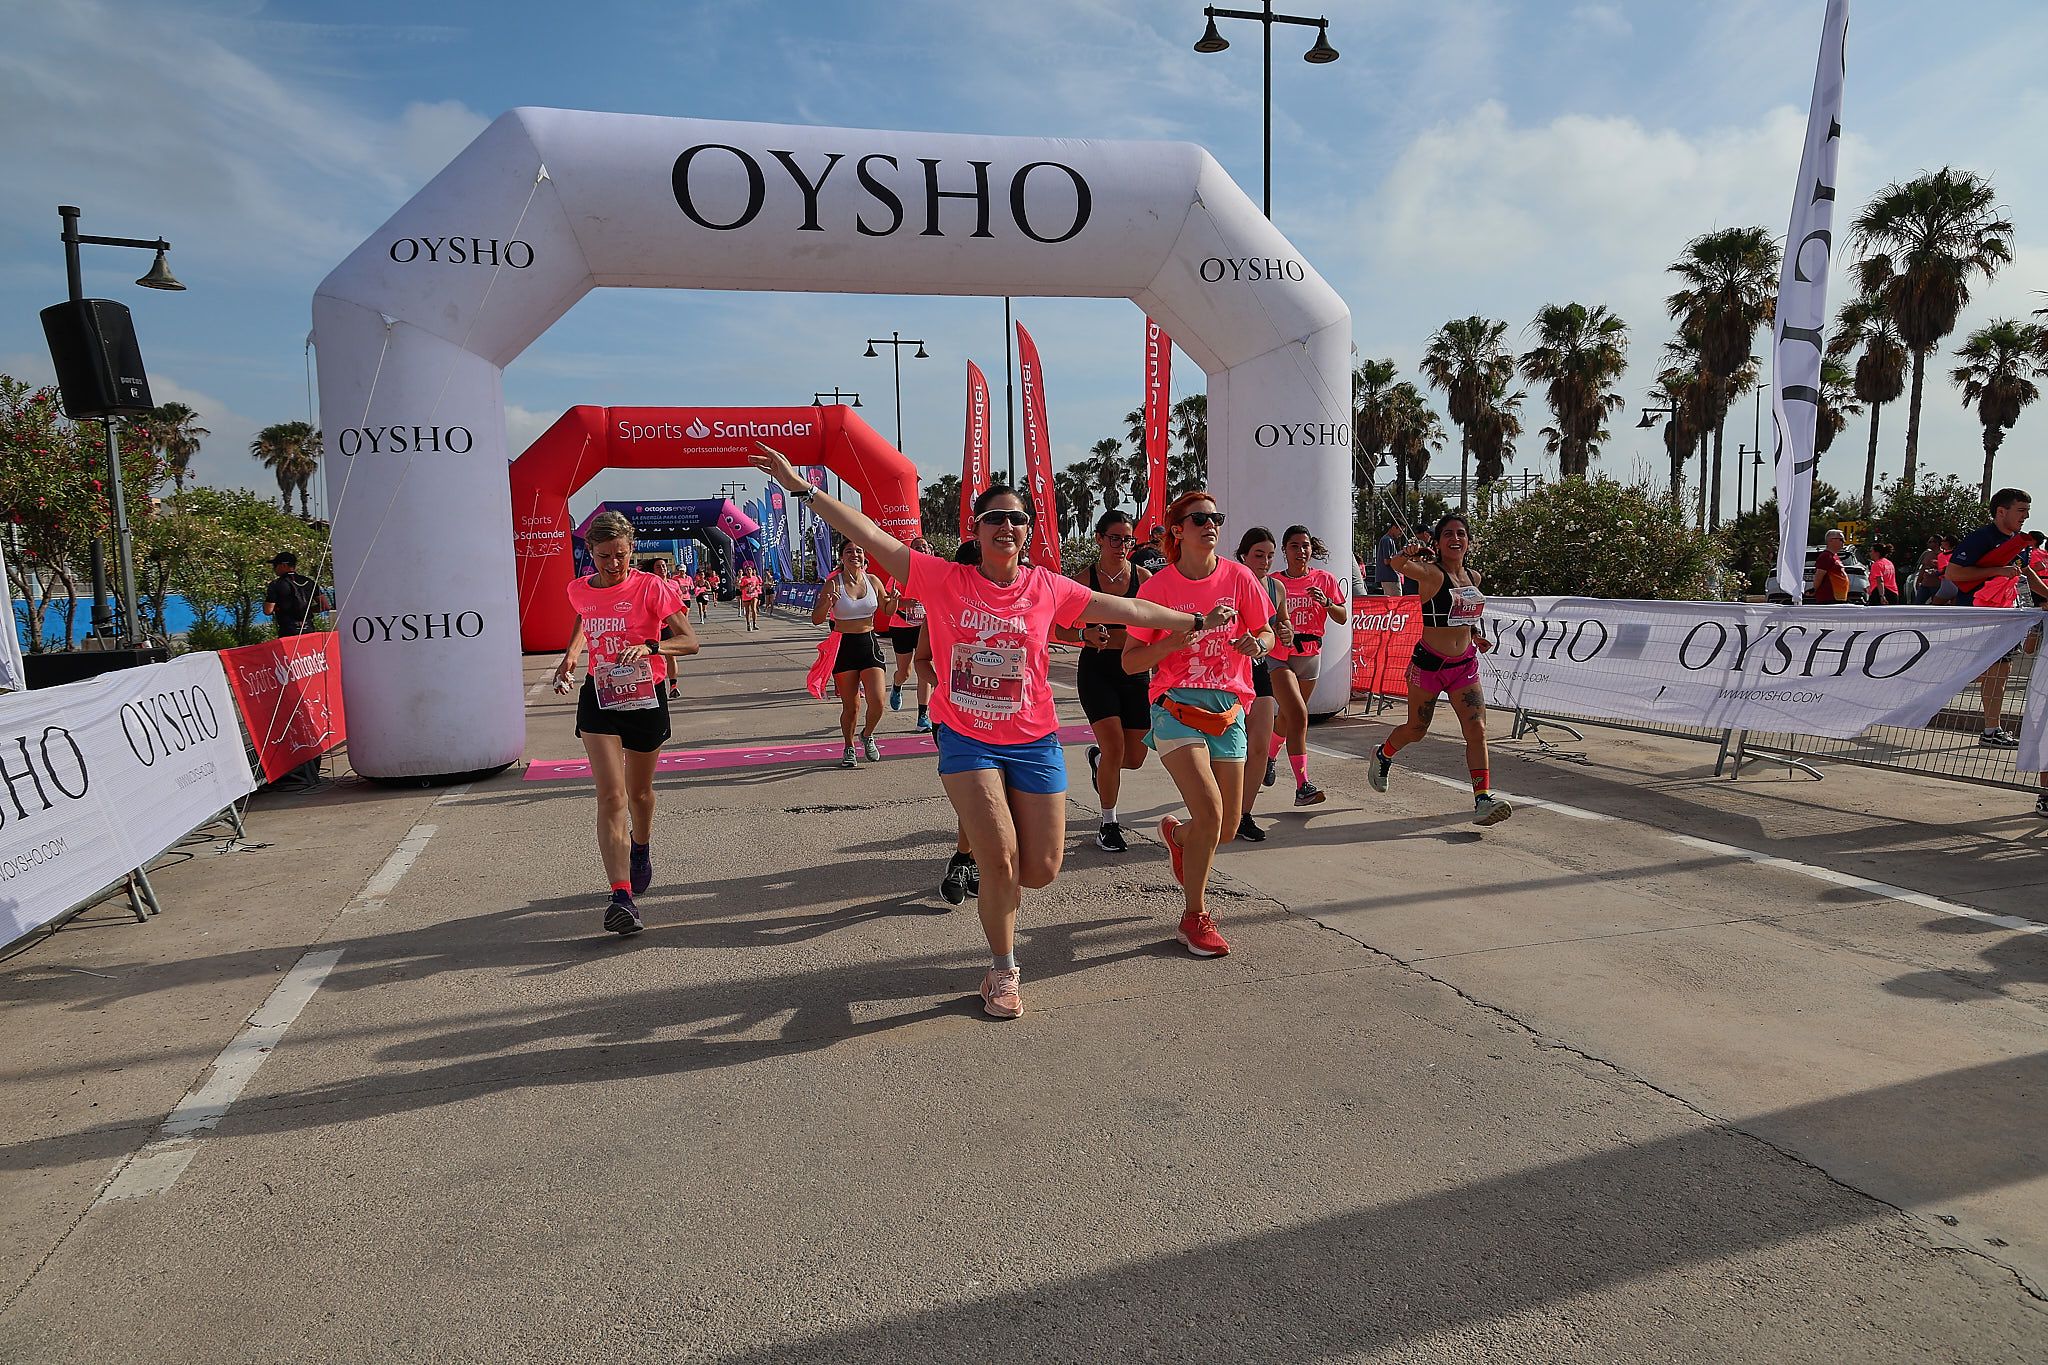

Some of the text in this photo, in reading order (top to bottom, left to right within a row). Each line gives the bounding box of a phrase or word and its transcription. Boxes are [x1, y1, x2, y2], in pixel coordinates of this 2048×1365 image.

[671, 142, 1091, 243] OYSHO
[390, 235, 535, 269] OYSHO
[1199, 256, 1305, 283] OYSHO
[339, 424, 472, 456] OYSHO
[618, 420, 812, 443] Sports Santander
[1254, 422, 1349, 447] OYSHO
[682, 446, 748, 455] sportssantander.es
[644, 505, 673, 513] octopus
[883, 505, 910, 514] Sports
[521, 515, 552, 527] Sports
[882, 518, 919, 527] Santander
[520, 530, 566, 540] Santander
[718, 548, 728, 594] VOLVO
[352, 610, 485, 644] OYSHO
[1352, 609, 1409, 632] ntander
[1678, 620, 1930, 680] OYSHO
[239, 648, 330, 703] Sports Santander
[972, 675, 1000, 689] 016
[615, 683, 637, 695] 016
[1718, 687, 1824, 705] WWW.OYSHO.COM
[957, 696, 978, 706] OYSHO
[119, 684, 219, 768] OYSHO
[974, 718, 993, 730] 2026
